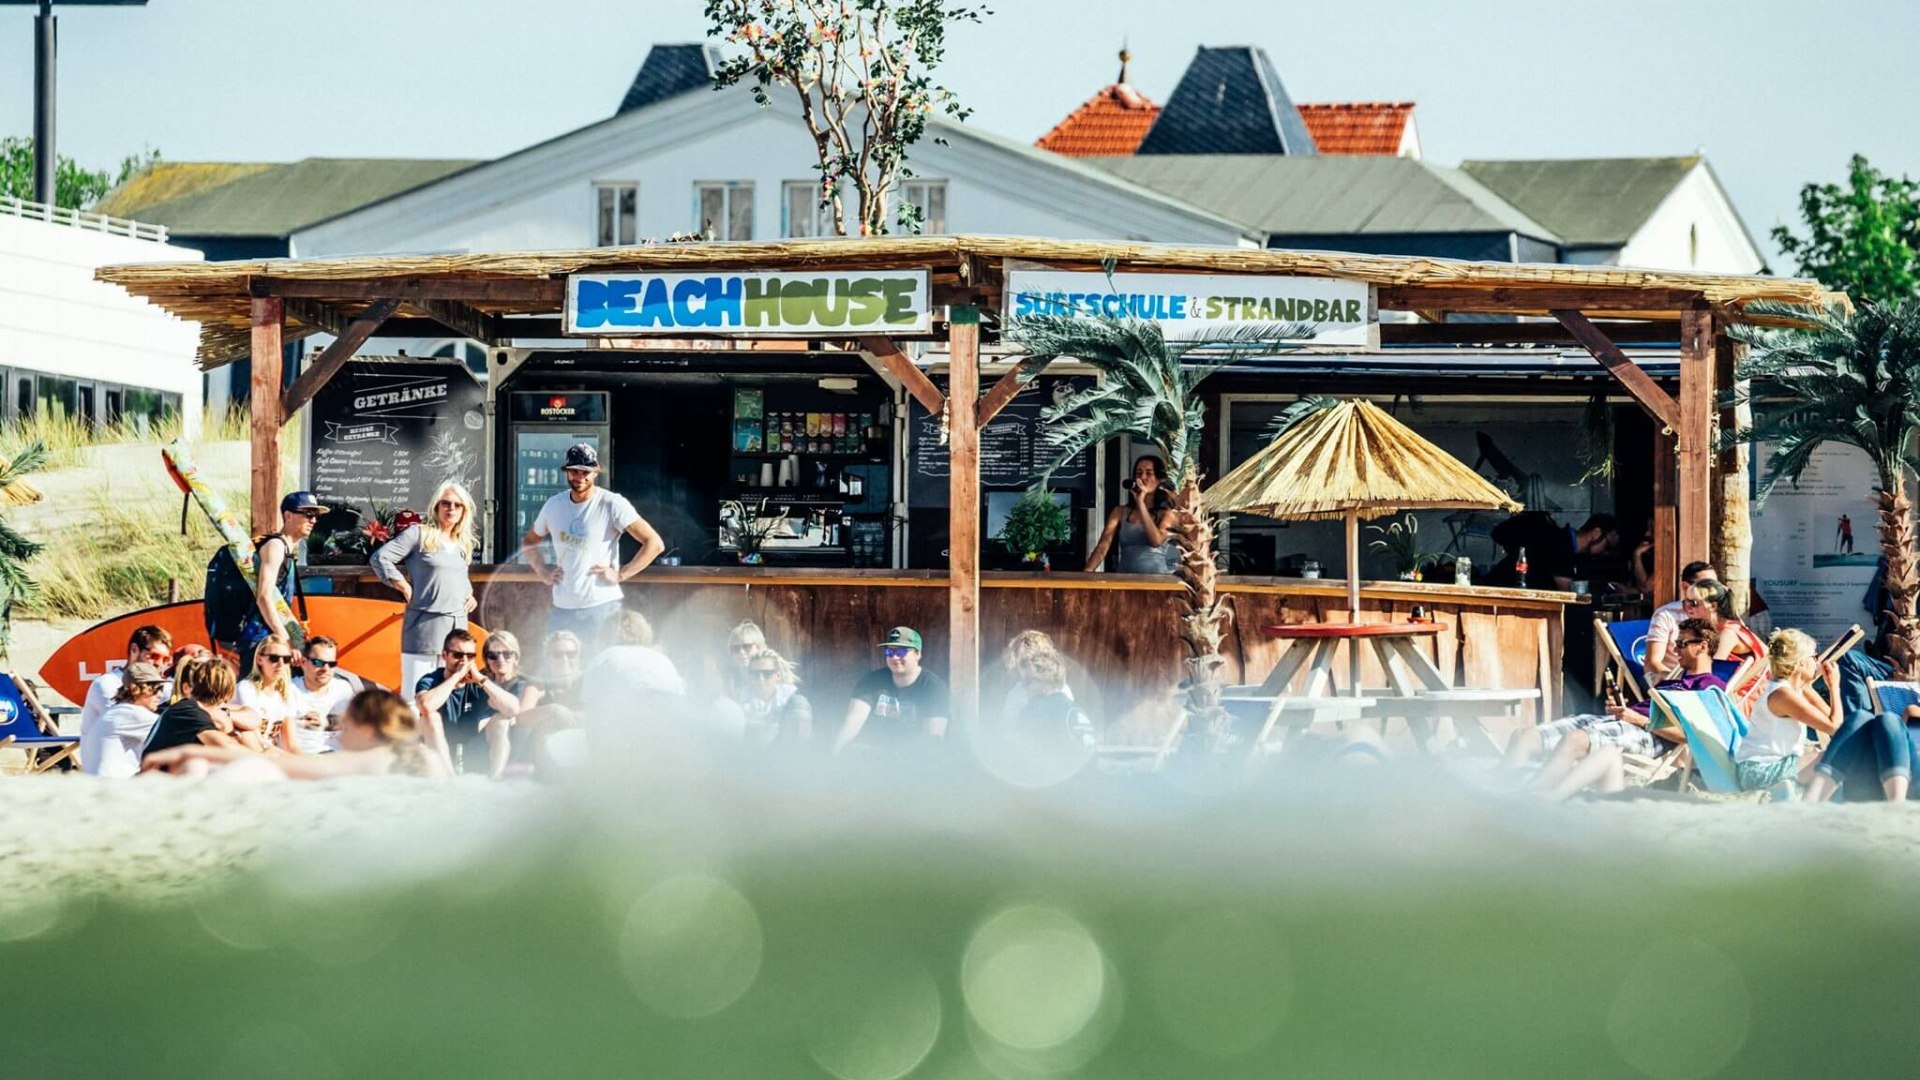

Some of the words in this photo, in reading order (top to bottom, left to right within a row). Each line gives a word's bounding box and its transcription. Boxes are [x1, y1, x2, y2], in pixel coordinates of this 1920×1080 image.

[1014, 292, 1187, 320] SURFSCHULE
[1190, 296, 1202, 319] &
[1205, 295, 1362, 323] STRANDBAR
[353, 384, 448, 410] GETRÄNKE
[540, 407, 576, 415] ROSTOCKER
